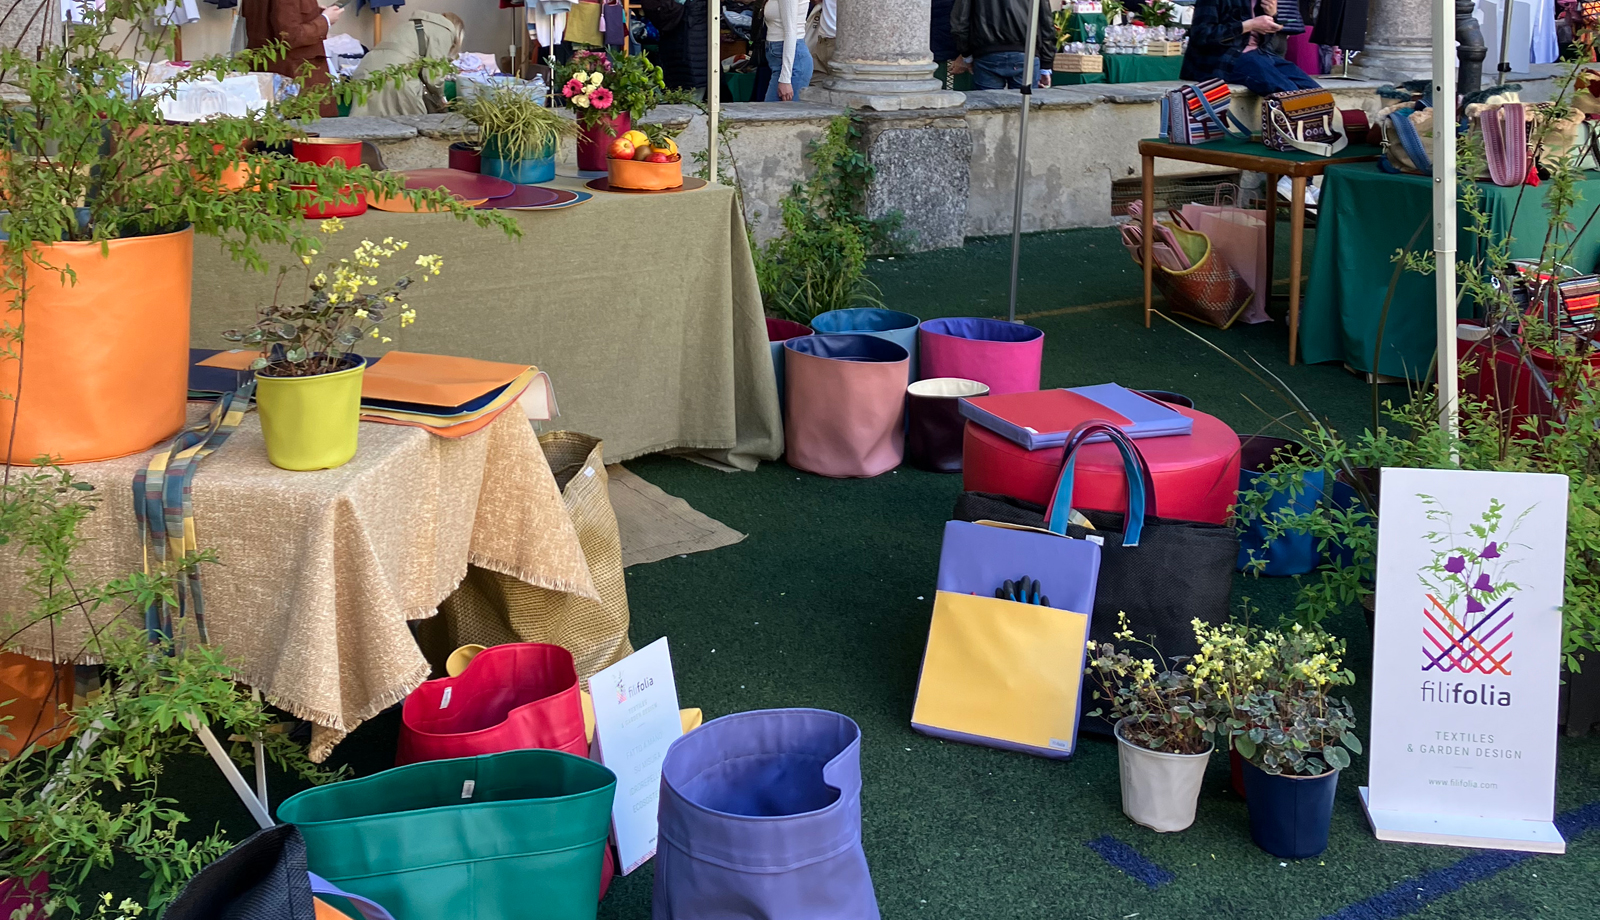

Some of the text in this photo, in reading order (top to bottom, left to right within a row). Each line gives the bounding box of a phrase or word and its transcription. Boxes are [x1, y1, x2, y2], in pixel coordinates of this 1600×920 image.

[628, 677, 654, 698] filifolia
[1421, 680, 1511, 706] filifolia
[626, 744, 643, 760] FATTO
[647, 731, 663, 746] MANO
[1435, 731, 1494, 743] TEXTILES
[1407, 743, 1522, 759] & GARDEN DESIGN
[1429, 778, 1498, 789] www.filifolia.com
